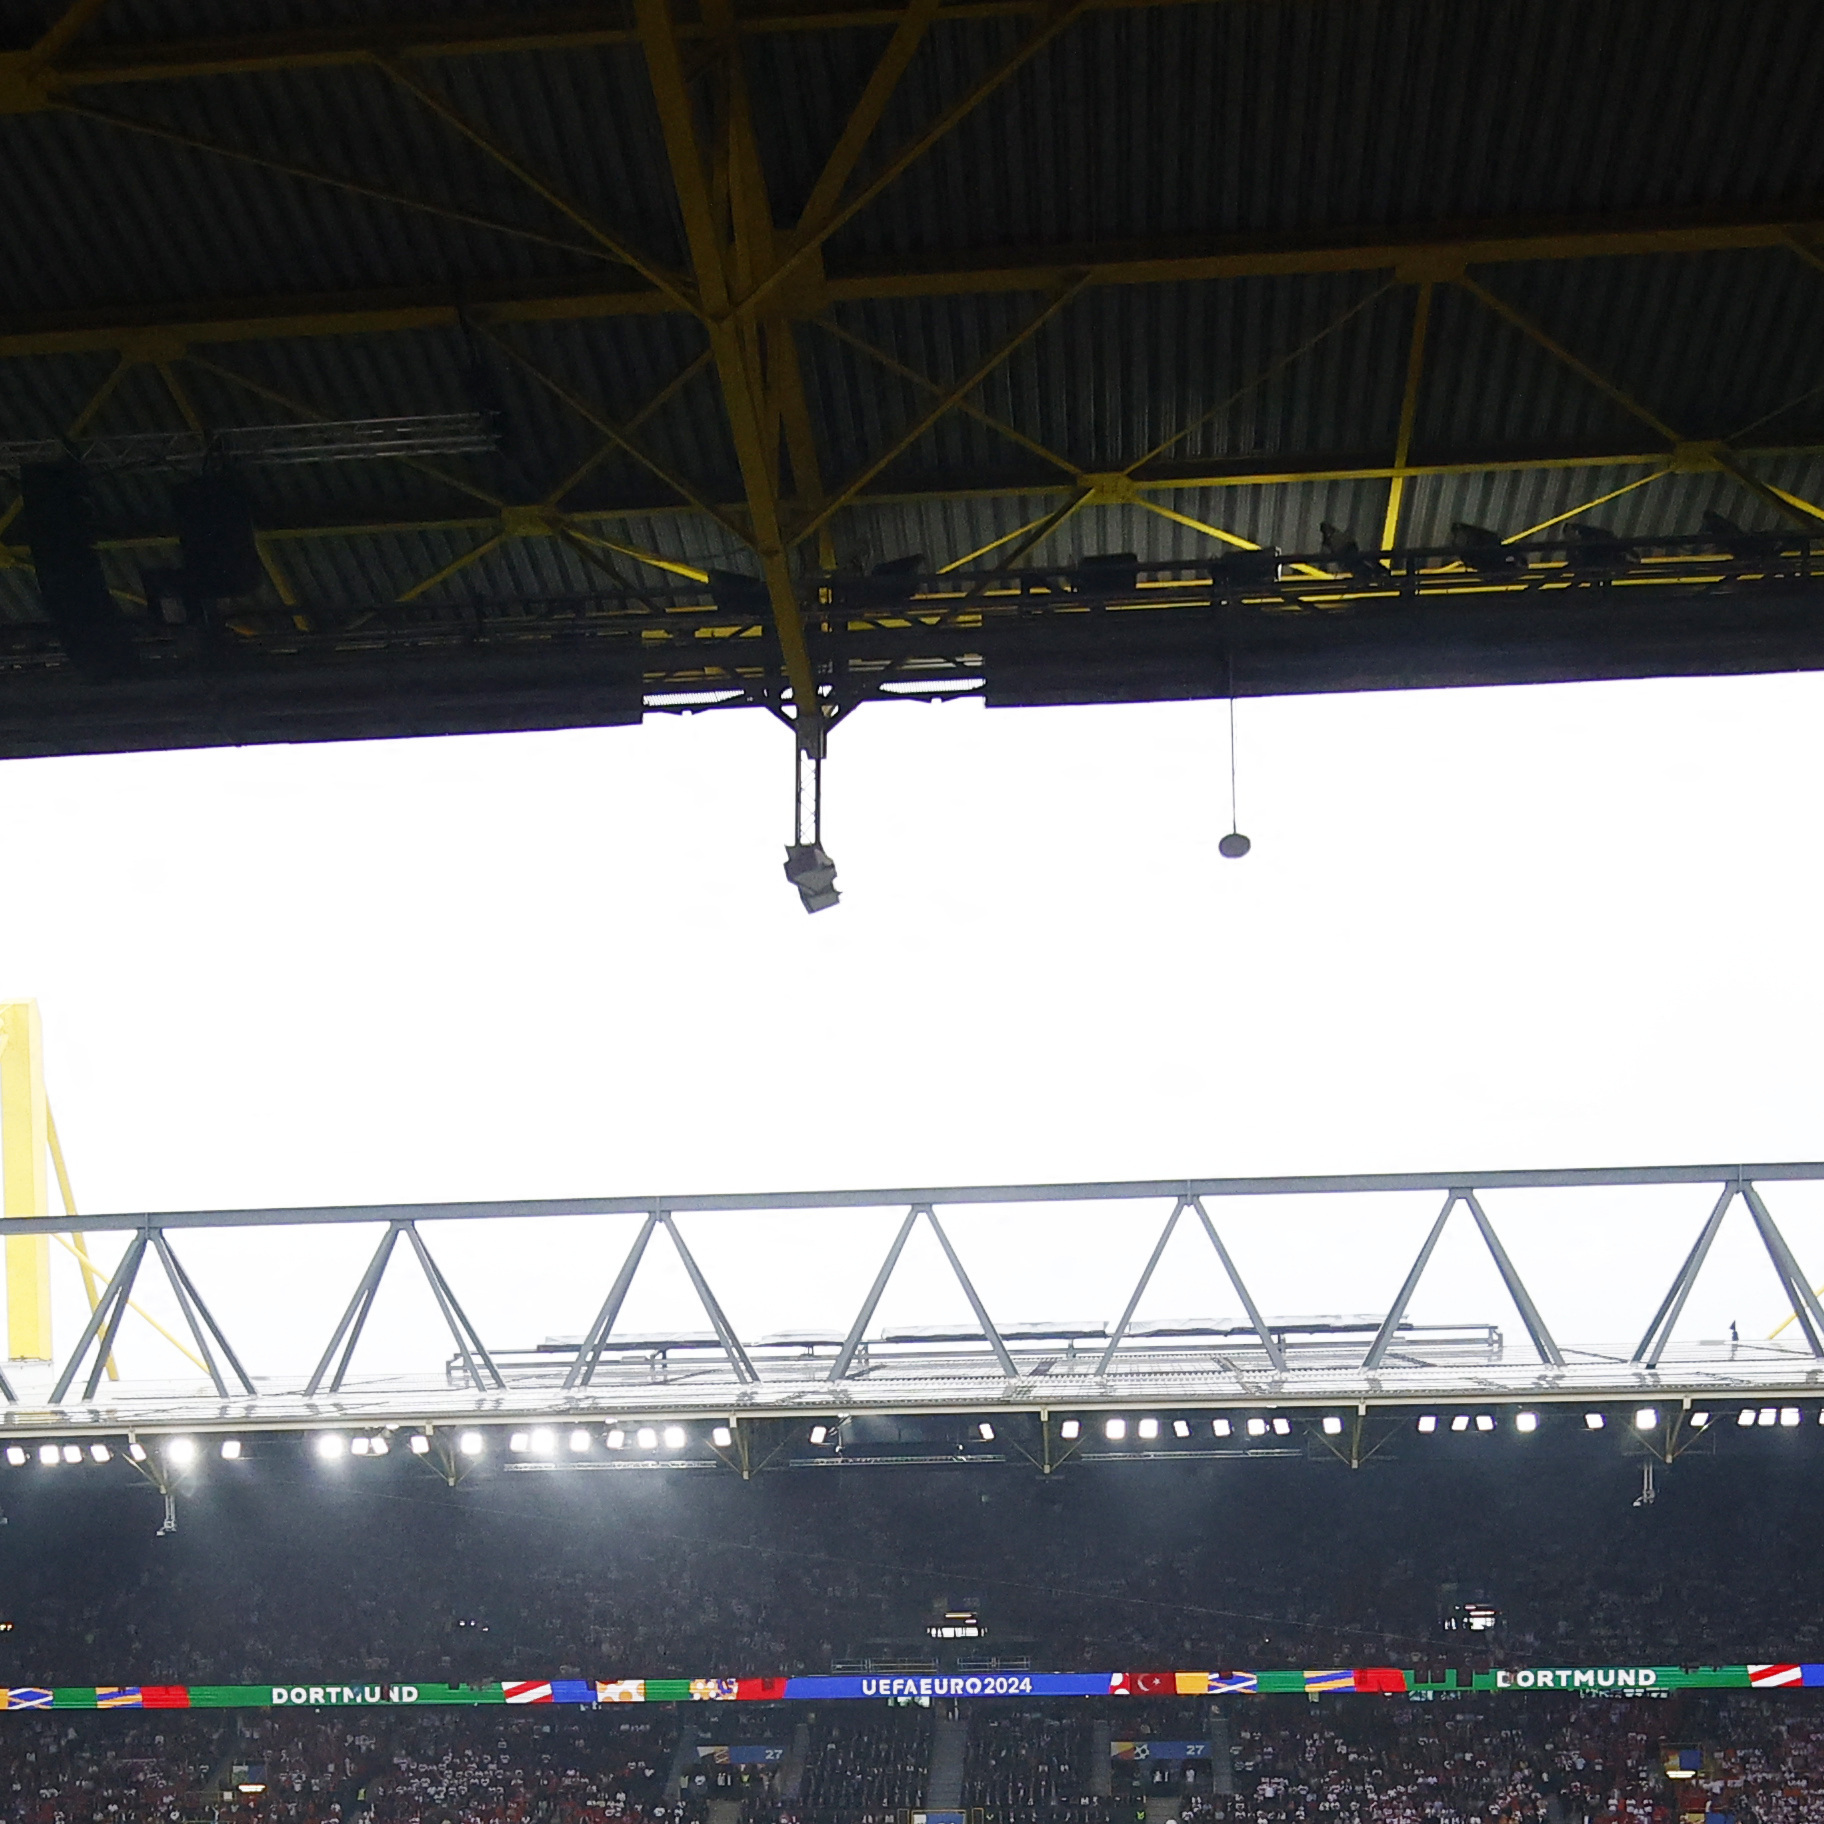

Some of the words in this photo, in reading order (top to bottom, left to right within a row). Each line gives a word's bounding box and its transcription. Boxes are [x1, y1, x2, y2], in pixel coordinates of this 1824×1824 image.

[1496, 1669, 1656, 1688] DORTMUND
[272, 1686, 418, 1704] DORTMUND
[765, 1749, 783, 1760] 27
[1186, 1745, 1205, 1756] 27
